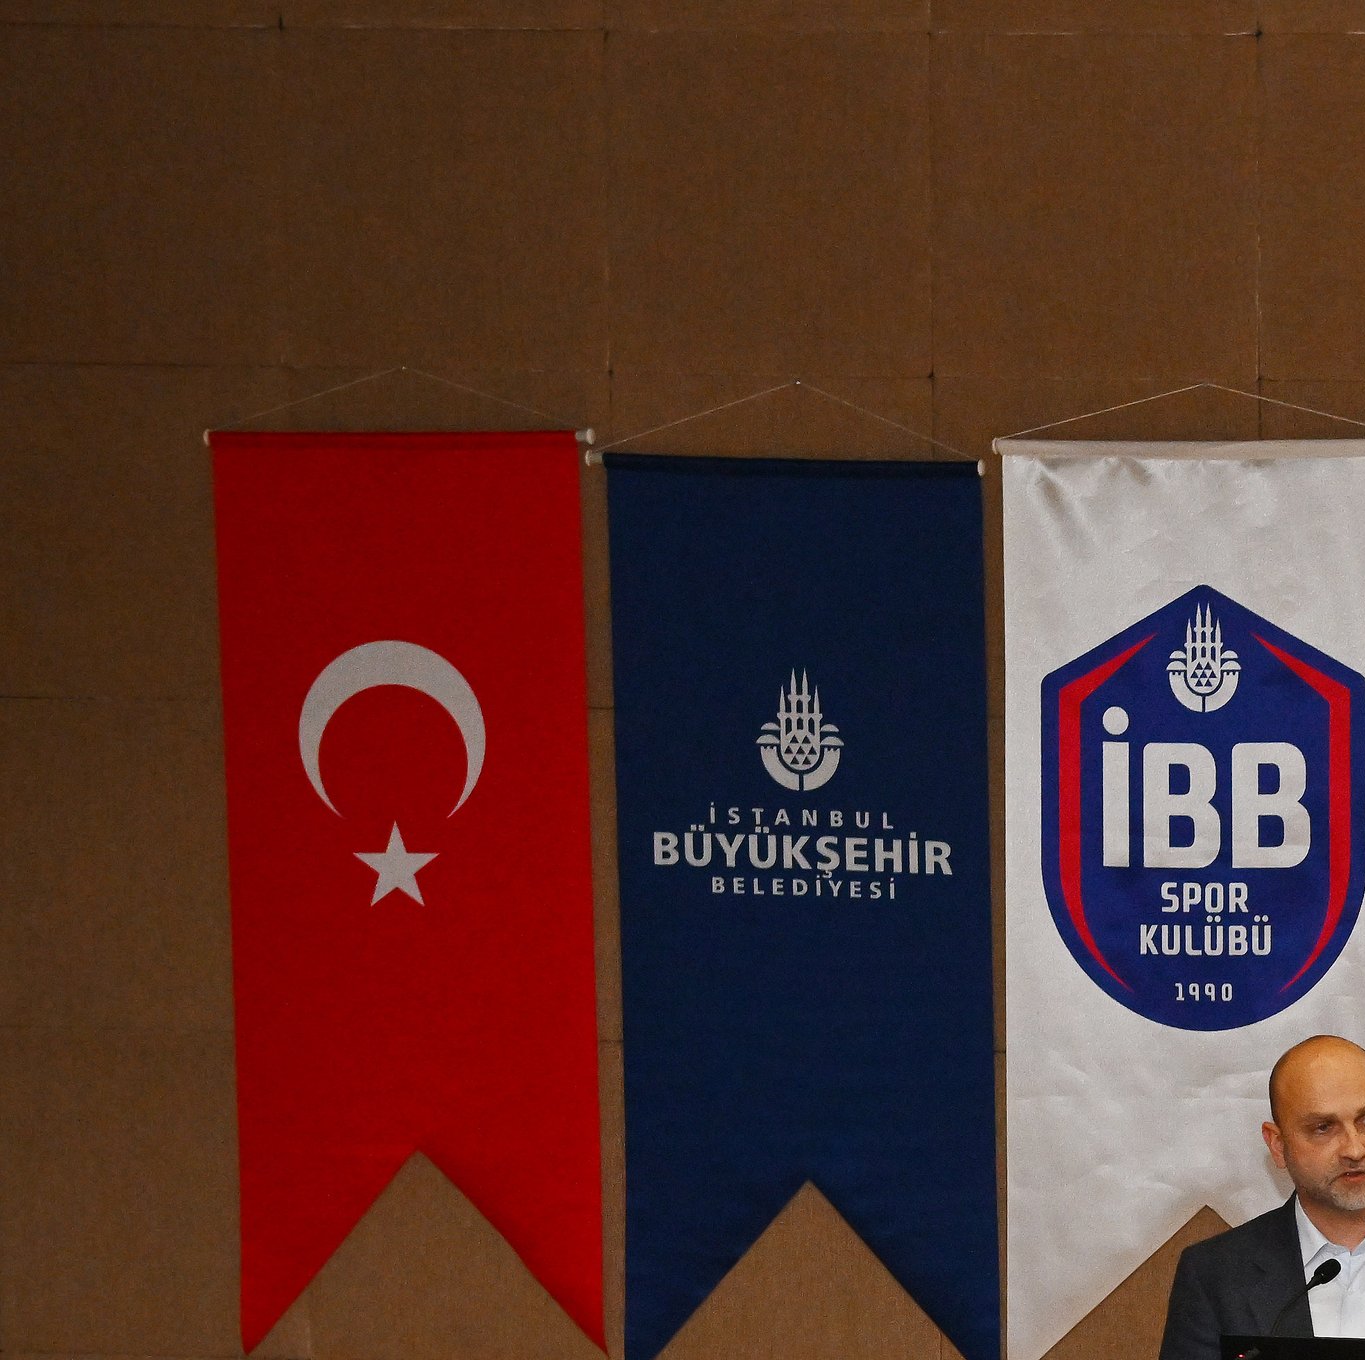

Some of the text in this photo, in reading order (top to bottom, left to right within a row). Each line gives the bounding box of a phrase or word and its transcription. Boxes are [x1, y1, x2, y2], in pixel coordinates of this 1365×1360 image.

[1102, 706, 1311, 869] İBB
[709, 802, 895, 830] İSTANBUL
[653, 824, 953, 878] BÜYÜKŞEHİR
[711, 874, 896, 900] BELEDİYESİ
[1160, 882, 1249, 913] SPOR
[1139, 915, 1273, 956] KULÜBÜ
[1174, 983, 1233, 1001] 1990
